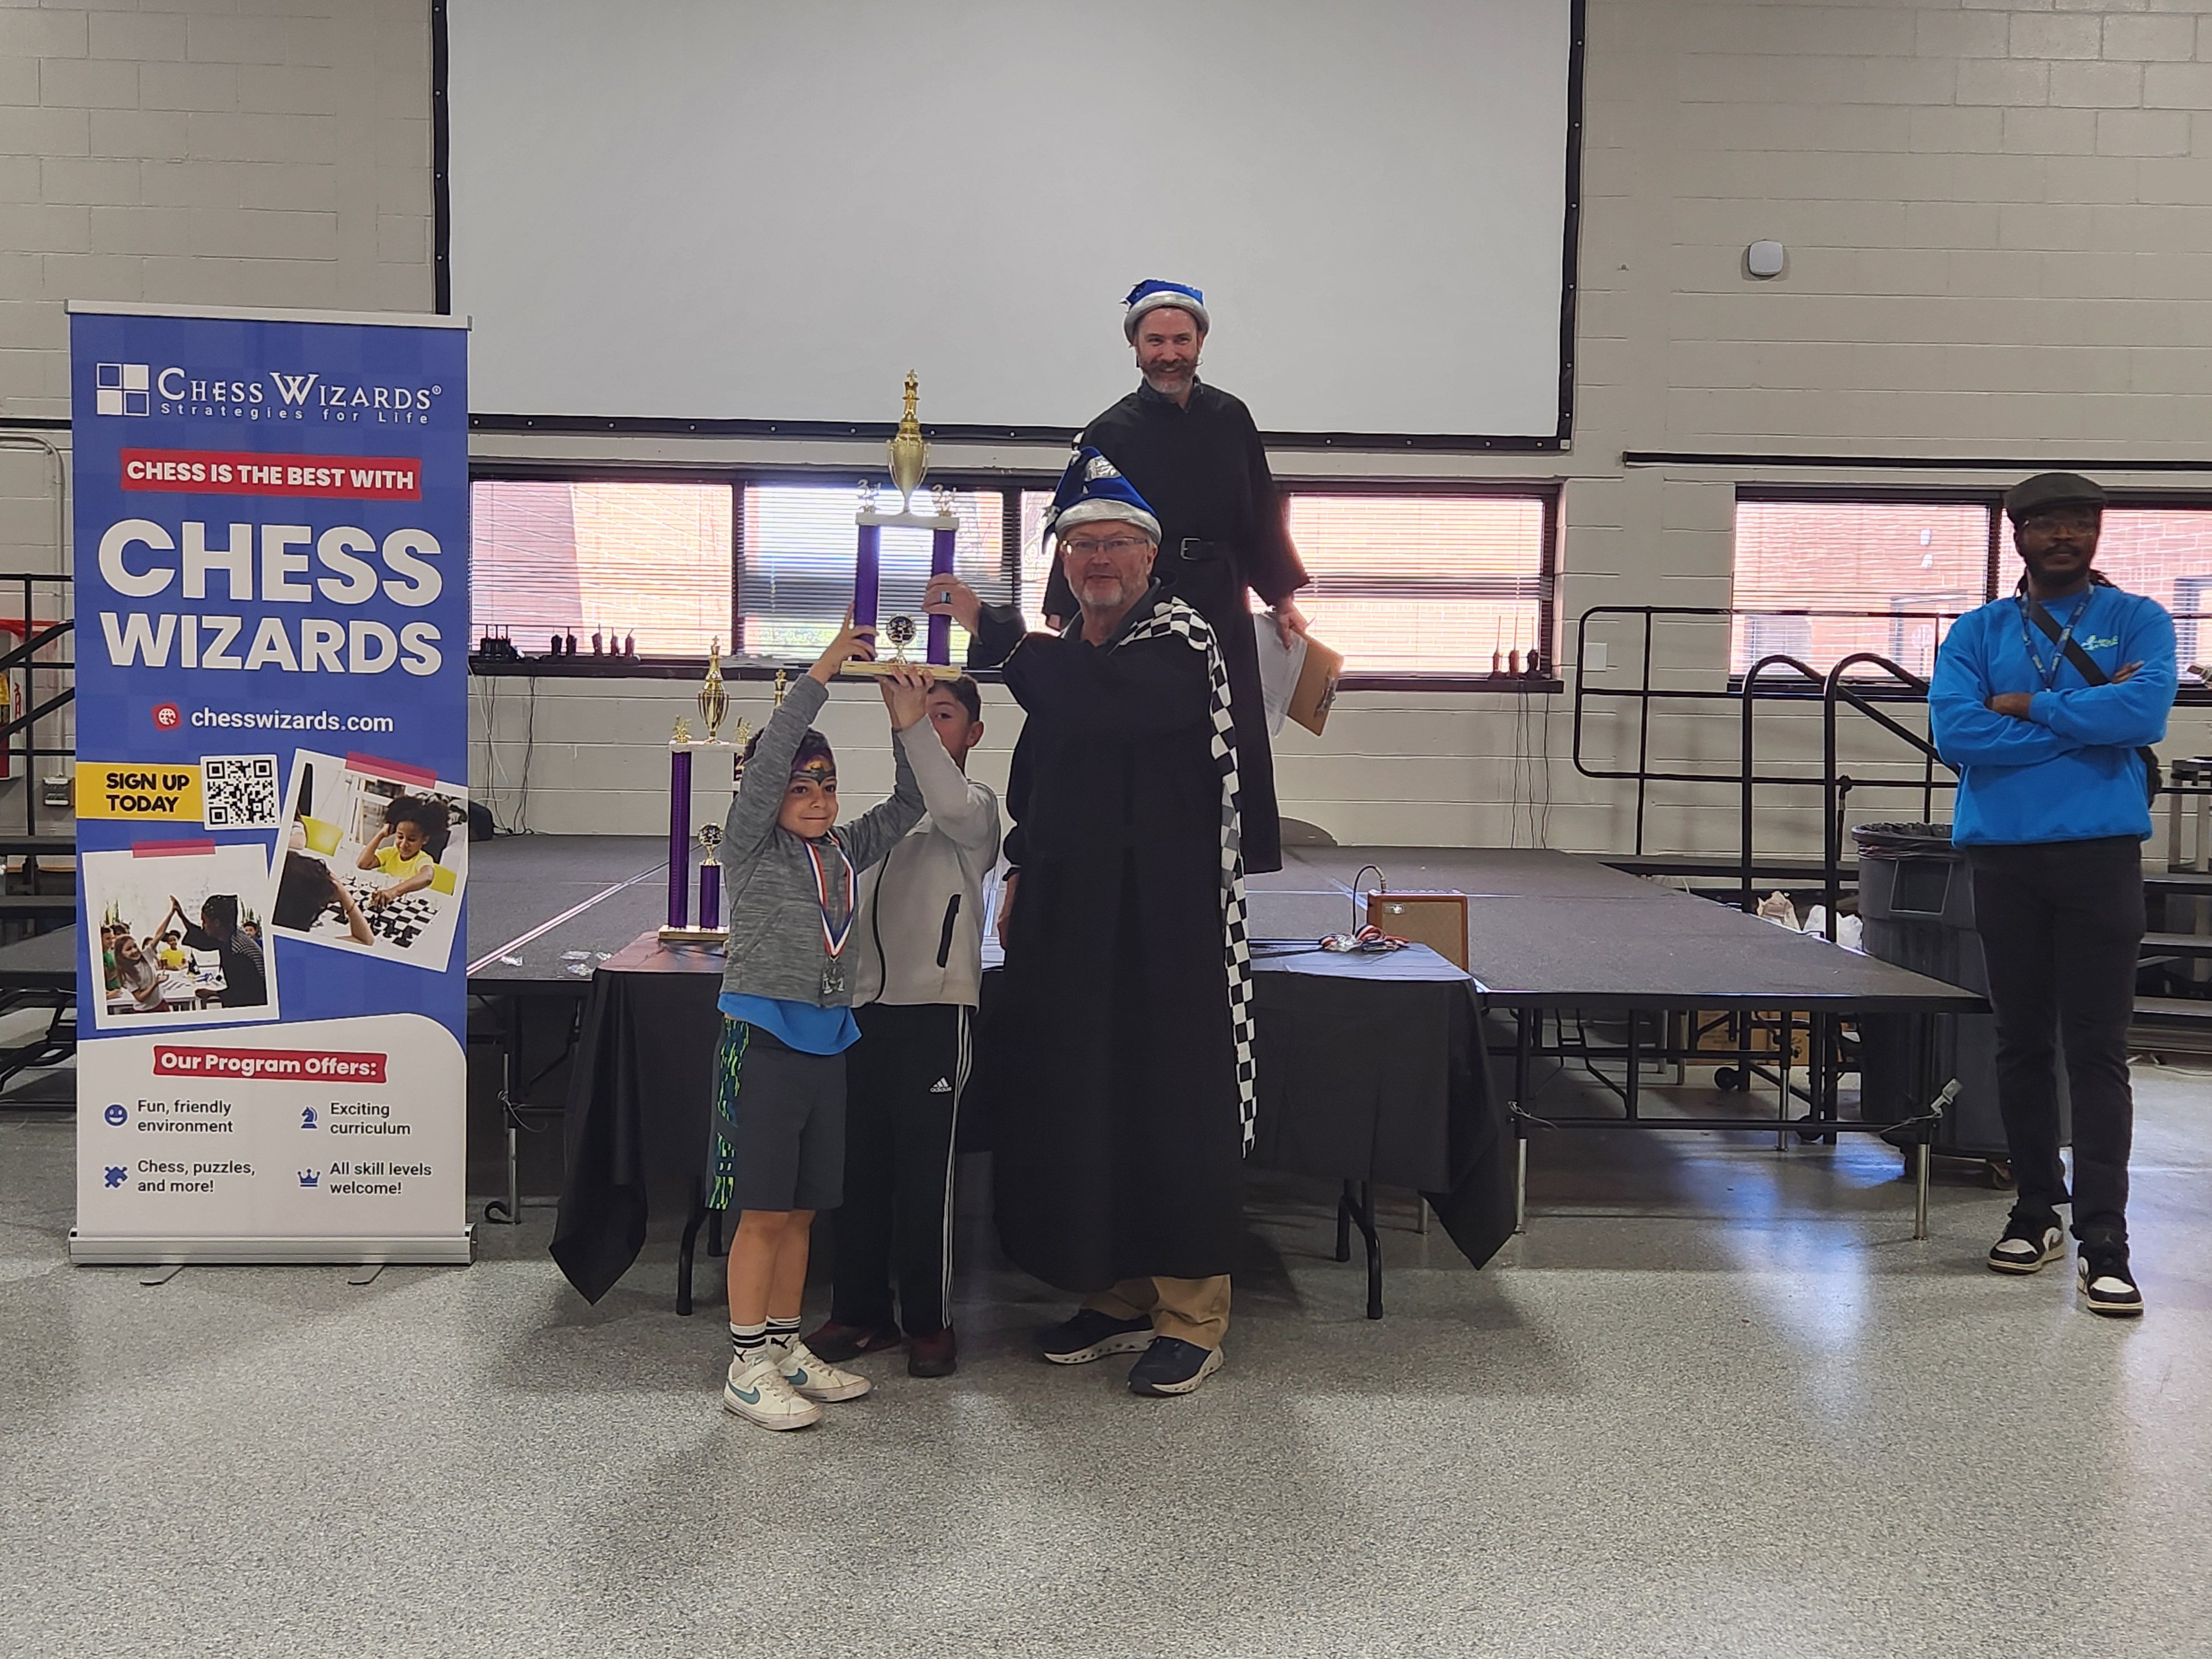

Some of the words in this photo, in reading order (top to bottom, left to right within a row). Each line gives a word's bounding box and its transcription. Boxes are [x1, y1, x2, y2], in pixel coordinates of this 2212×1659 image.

[158, 367, 263, 403] CHESS
[161, 403, 303, 420] Strategies
[323, 409, 358, 422] for
[378, 411, 429, 425] Life
[127, 461, 206, 482] CHESS
[211, 464, 232, 483] IS
[237, 465, 283, 484] THE
[287, 467, 346, 487] BEST
[349, 469, 414, 489] WITH
[98, 519, 442, 607] CHESS
[99, 612, 442, 676] WIZARDS
[191, 707, 393, 732] chesswizards.com
[106, 773, 156, 790] SIGN
[162, 774, 190, 791] UP
[106, 794, 179, 812] TODAY
[161, 1052, 202, 1070] Our
[205, 1054, 300, 1076] Program
[305, 1057, 377, 1076] Offers:
[138, 1099, 169, 1115] Fun,
[174, 1100, 231, 1117] friendly
[331, 1102, 389, 1119] Exciting
[138, 1119, 233, 1133] environment
[330, 1121, 410, 1135] curriculum
[138, 1159, 189, 1176] Chess,
[194, 1160, 255, 1177] puzzles,
[330, 1162, 349, 1175] All
[354, 1162, 384, 1175] skill
[389, 1162, 432, 1176] levels
[138, 1178, 165, 1192] and
[170, 1180, 213, 1193] more!
[330, 1181, 401, 1194] welcome!
